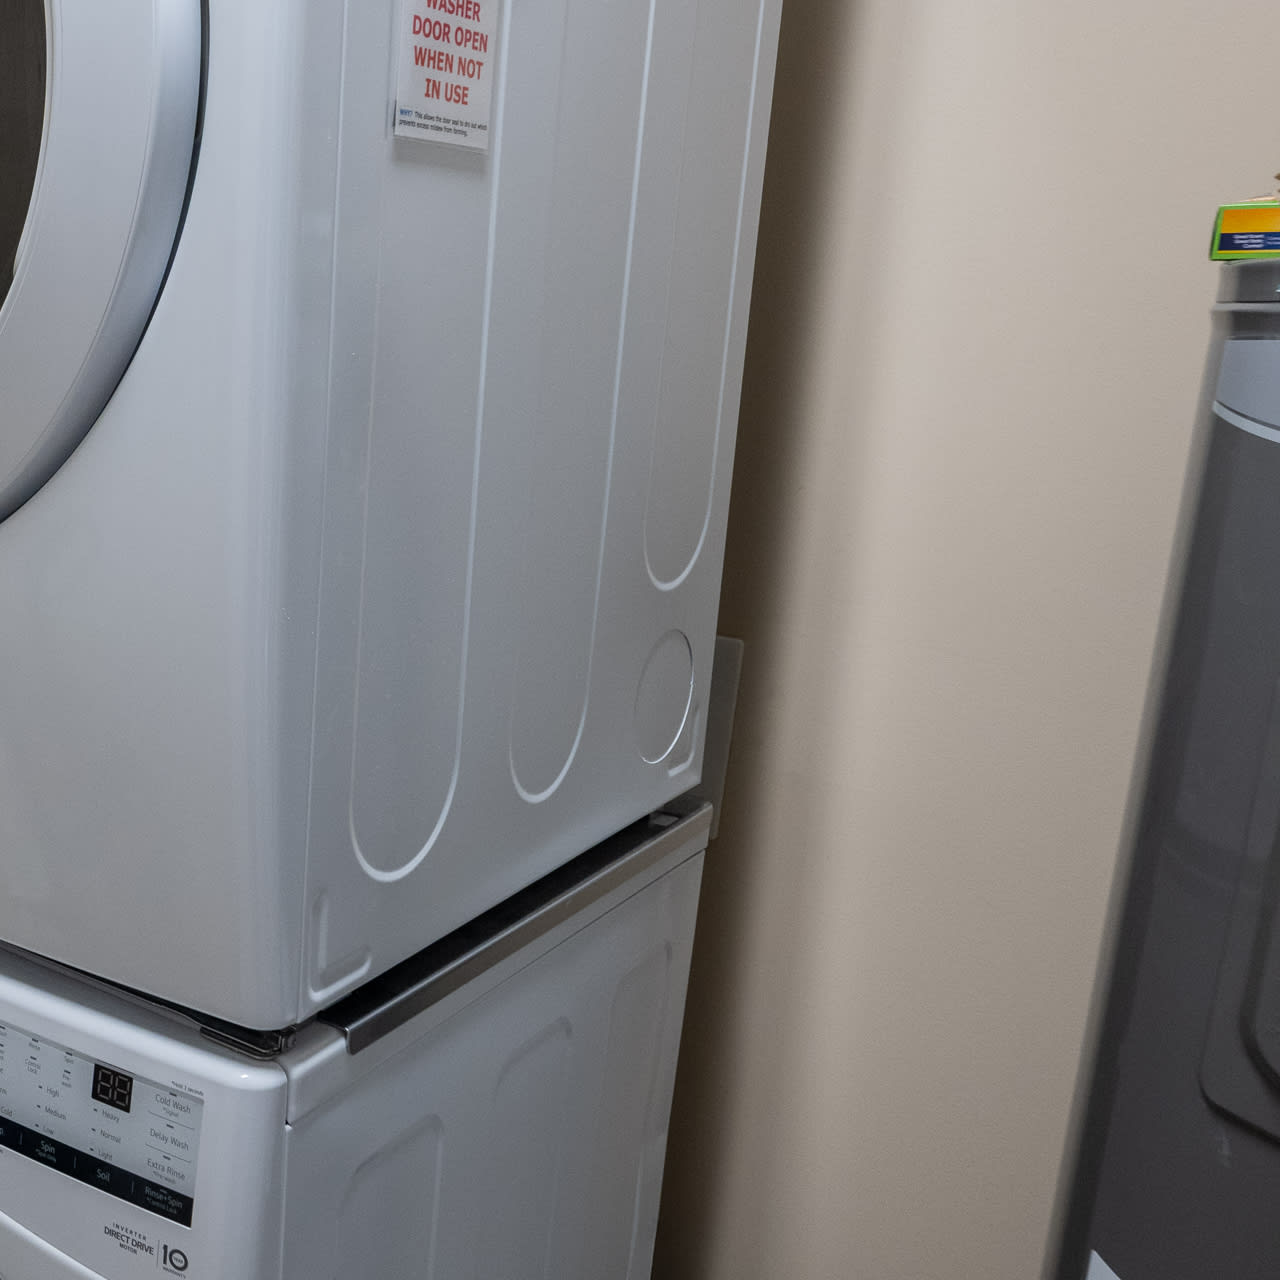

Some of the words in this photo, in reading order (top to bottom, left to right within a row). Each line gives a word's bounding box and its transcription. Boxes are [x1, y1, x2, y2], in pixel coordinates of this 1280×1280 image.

[412, 14, 451, 44] DOOR
[454, 26, 489, 54] OPEN
[414, 45, 454, 75] WHEN
[457, 55, 484, 81] NOT
[424, 77, 441, 100] IN
[444, 81, 470, 106] USE
[46, 1086, 60, 1098] High
[44, 1104, 67, 1120] Medium
[155, 1094, 172, 1107] Cold
[172, 1100, 191, 1114] Wash
[102, 1110, 120, 1123] Heavy
[42, 1122, 55, 1135] Low
[100, 1129, 122, 1144] Normal
[40, 1140, 56, 1154] Spin
[150, 1128, 169, 1145] Delay
[169, 1136, 189, 1151] Wash
[97, 1147, 113, 1162] Light
[96, 1168, 111, 1182] Soil
[147, 1158, 165, 1173] Extra
[166, 1165, 186, 1181] Rinse
[145, 1186, 183, 1209] Rinse+Spin
[104, 1226, 130, 1245] DIRECT
[131, 1239, 155, 1256] DRIVE
[113, 1221, 147, 1241] INVERTER
[119, 1242, 138, 1256] MOTOR
[162, 1244, 189, 1272] 10
